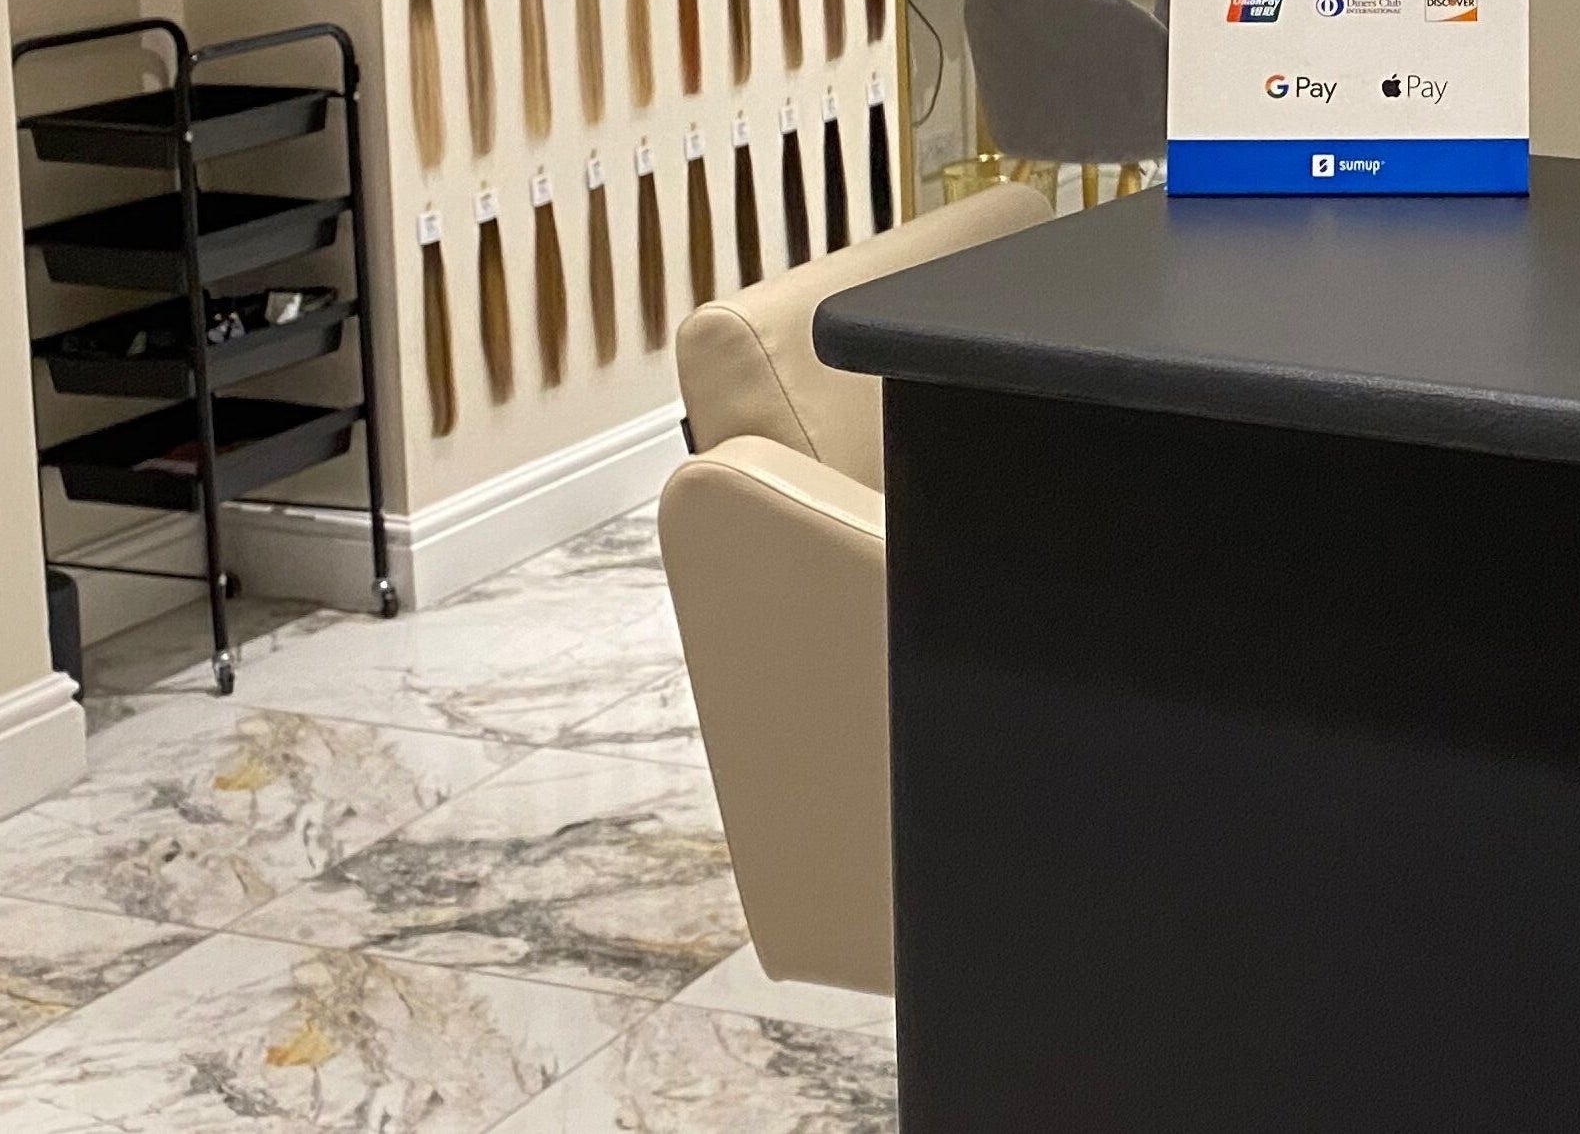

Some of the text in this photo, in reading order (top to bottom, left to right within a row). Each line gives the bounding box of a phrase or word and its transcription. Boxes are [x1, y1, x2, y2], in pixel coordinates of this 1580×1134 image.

[1296, 77, 1337, 103] Pay
[1407, 75, 1448, 104] Pay
[1339, 159, 1381, 175] sumup
